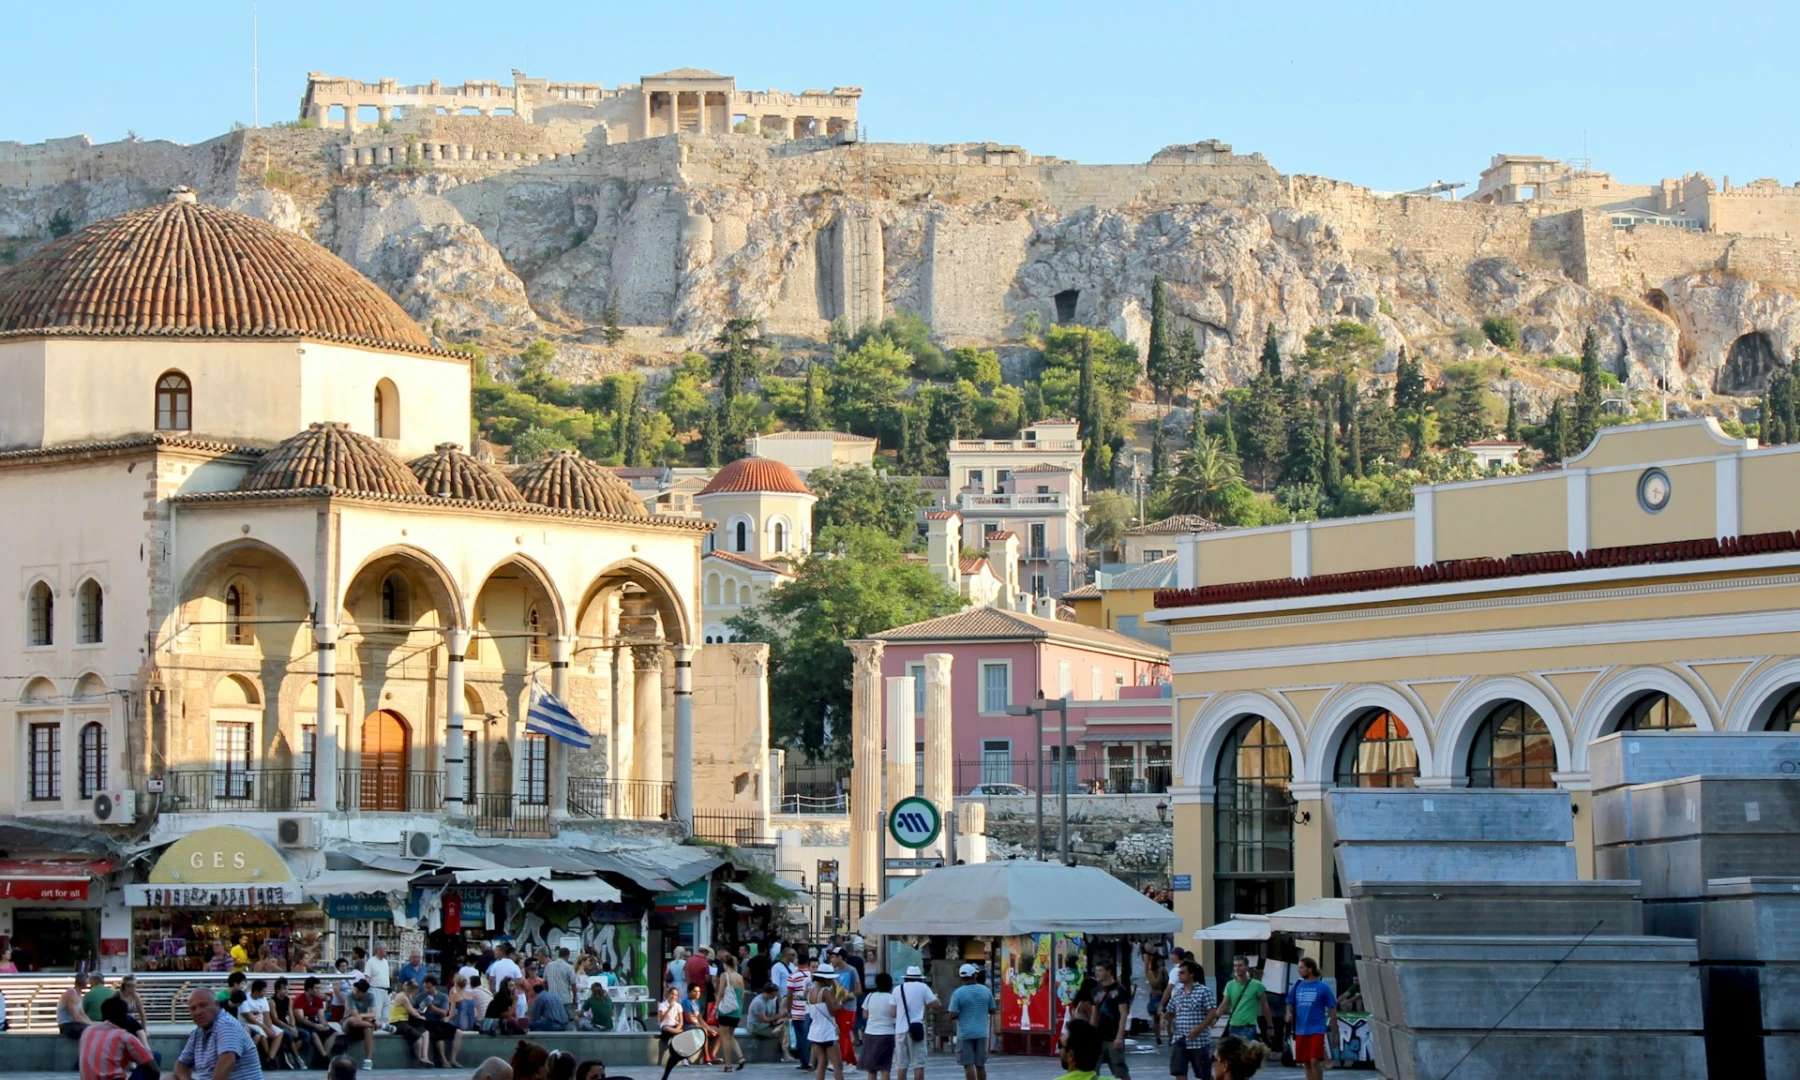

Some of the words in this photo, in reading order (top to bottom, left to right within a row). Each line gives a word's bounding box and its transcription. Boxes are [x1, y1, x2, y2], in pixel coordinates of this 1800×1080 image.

[190, 852, 245, 868] GES
[41, 889, 53, 897] art
[55, 889, 67, 897] for
[69, 889, 80, 897] all
